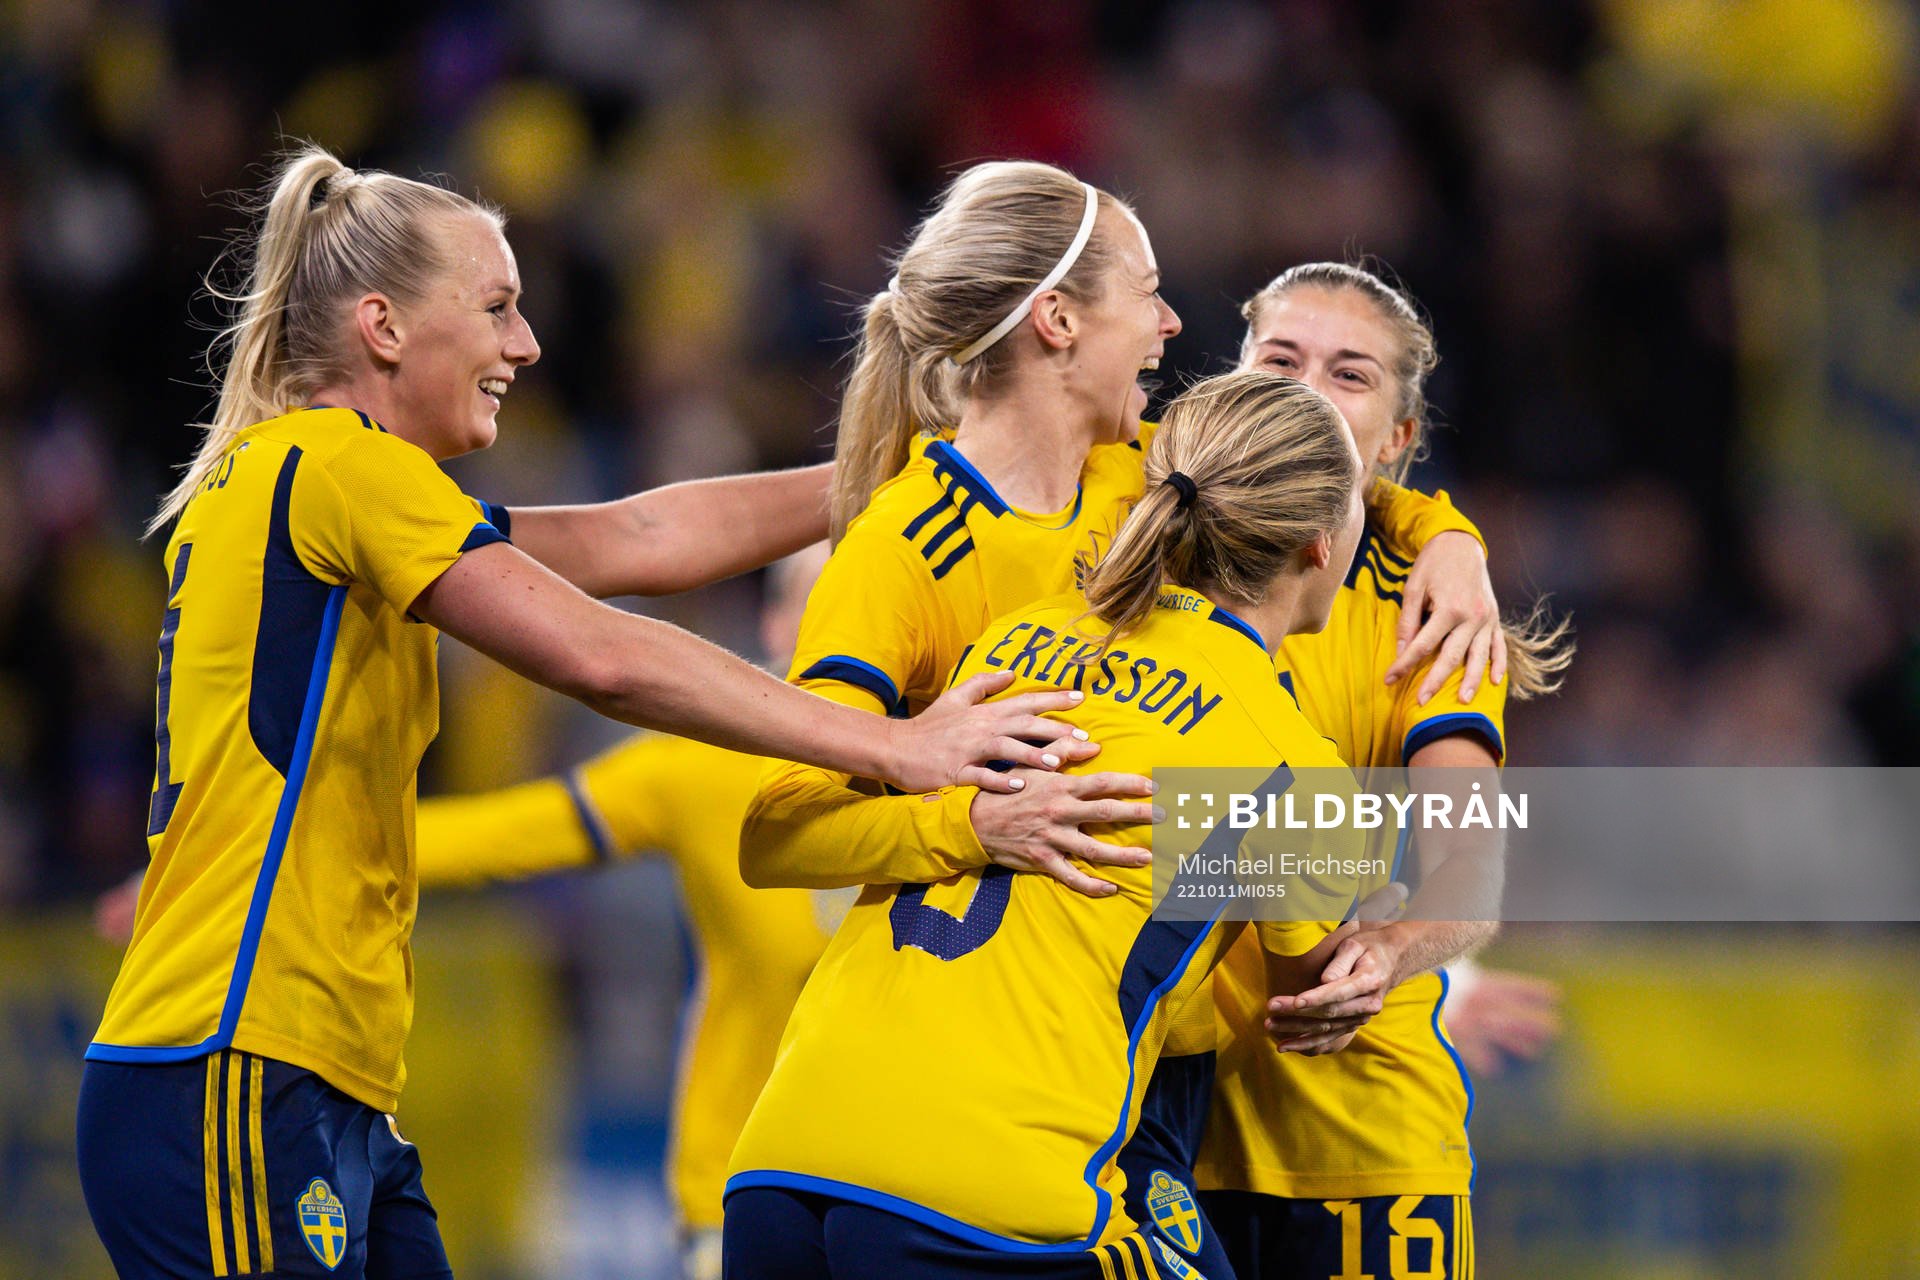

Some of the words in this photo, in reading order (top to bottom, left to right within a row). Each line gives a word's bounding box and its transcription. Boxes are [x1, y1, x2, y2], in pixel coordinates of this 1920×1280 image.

[985, 622, 1223, 736] ERIKSSON
[1156, 1191, 1185, 1206] SVERIGE
[1322, 1195, 1447, 1280] 16
